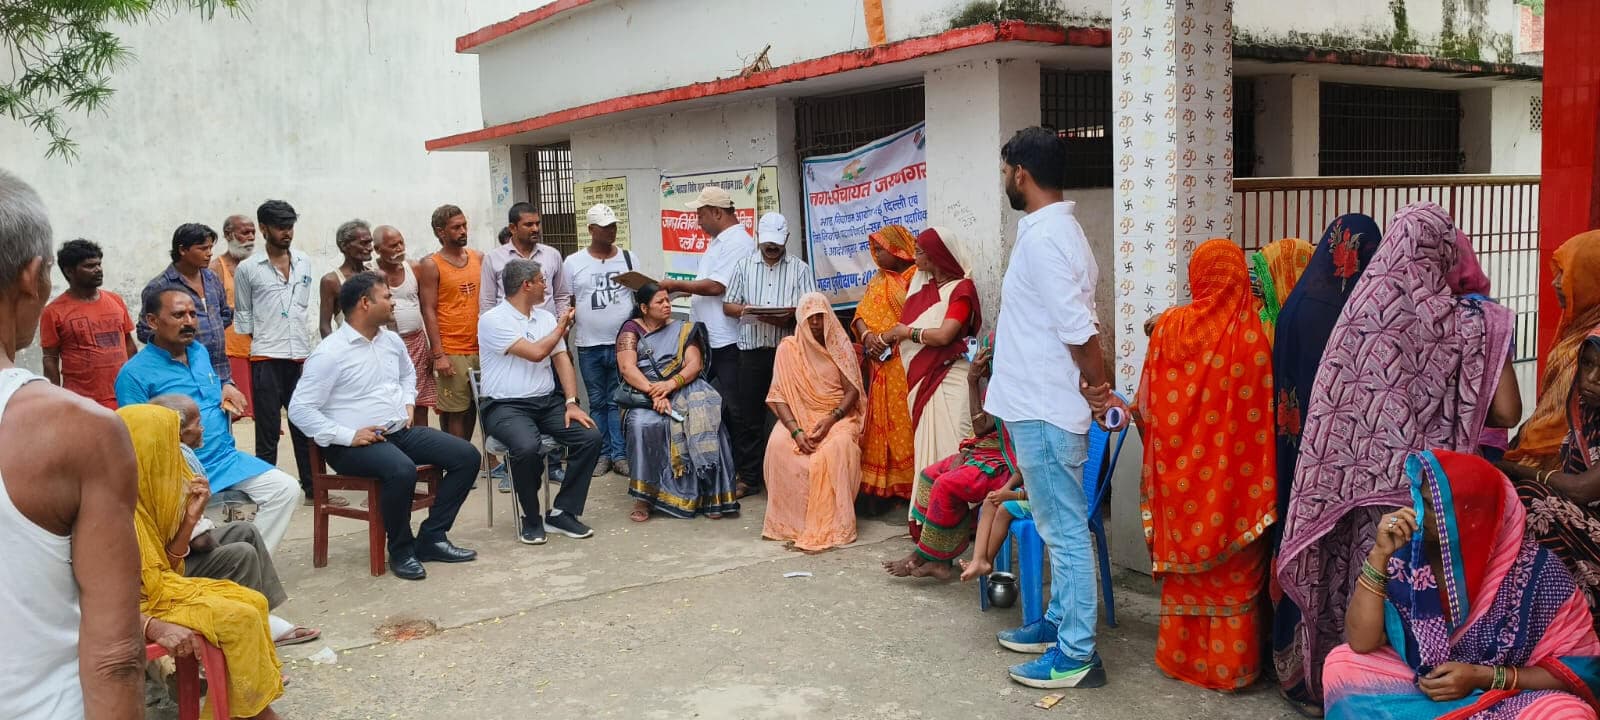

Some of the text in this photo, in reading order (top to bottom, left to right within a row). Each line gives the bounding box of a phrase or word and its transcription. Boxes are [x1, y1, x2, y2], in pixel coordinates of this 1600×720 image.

[884, 194, 908, 213] दिल्ली
[908, 191, 919, 207] एवं
[696, 235, 706, 251] के
